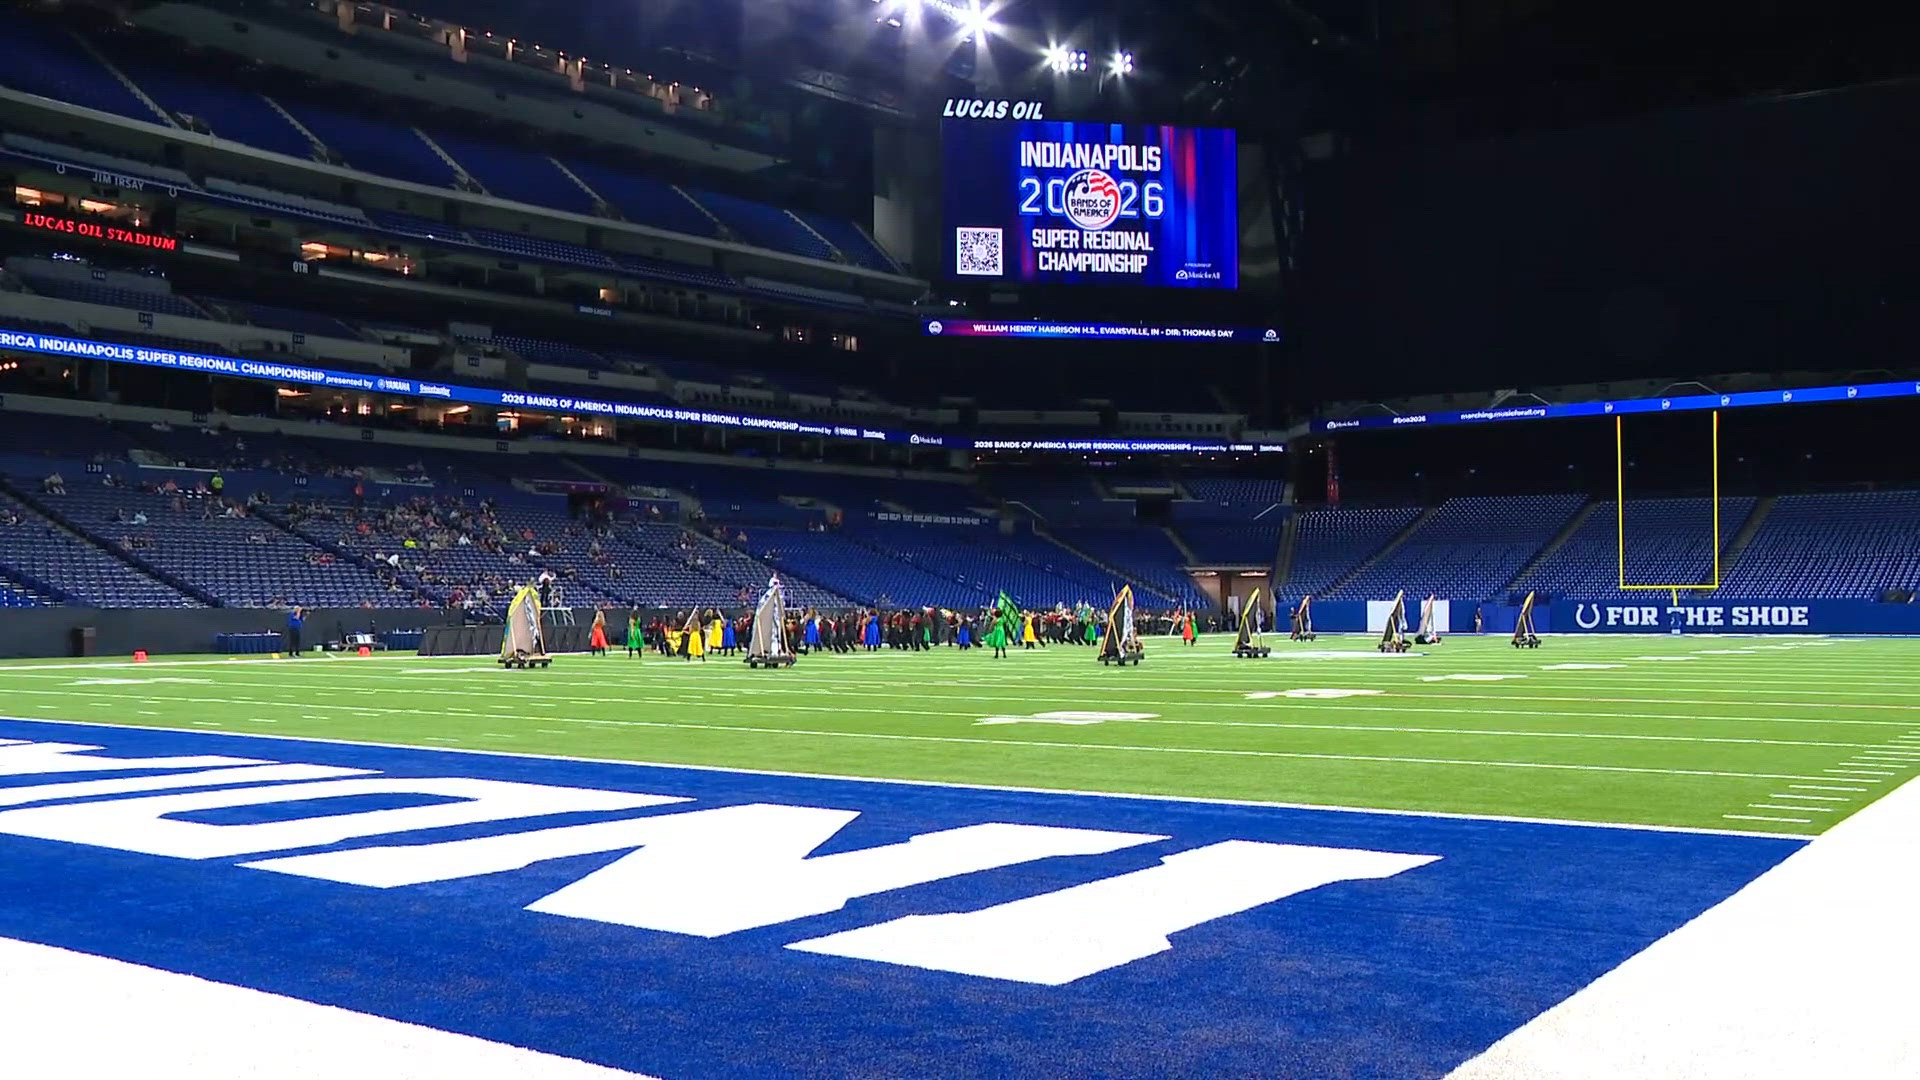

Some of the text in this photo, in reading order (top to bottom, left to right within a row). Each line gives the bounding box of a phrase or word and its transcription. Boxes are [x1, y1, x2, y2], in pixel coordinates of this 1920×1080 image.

[943, 99, 1043, 120] LUCAS OIL
[1020, 141, 1161, 172] INDIANAPOLIS
[92, 171, 145, 191] JIM IRSAY
[1071, 199, 1112, 208] BANDS OF
[1073, 208, 1109, 217] AMERICA
[24, 213, 177, 250] LUCAS OIL STADIUM
[1032, 228, 1154, 251] SUPER REGIONAL
[292, 261, 309, 274] QTR
[1038, 251, 1148, 274] CHAMPIONSHIP
[973, 324, 1008, 332] WILLIAM
[1010, 325, 1037, 333] HENRY
[1039, 325, 1081, 334] HARRISON
[1100, 327, 1150, 336] EVANSVILLE,
[1151, 328, 1160, 336] IN
[1165, 328, 1181, 336] DIR:
[1182, 329, 1216, 337] THOMAS
[1217, 329, 1234, 338] DAY
[39, 337, 134, 360] INDIANAPOLIS
[136, 350, 177, 365] SUPER
[179, 356, 239, 372] REGIONAL
[241, 362, 325, 382] CHAMPIONSHIP
[326, 375, 363, 387] presented
[363, 379, 373, 389] by
[385, 379, 411, 392] YAMAHA
[502, 393, 525, 404] 2026
[526, 395, 558, 408] BANDS
[560, 398, 572, 409] OF
[573, 400, 613, 413] AMERICA
[615, 404, 673, 419] INDIANAPOLIS
[675, 410, 700, 422] SUPER
[702, 413, 741, 426] REGIONAL
[742, 417, 798, 431] CHAMPIONSHIP
[799, 425, 825, 434] presented
[825, 426, 831, 435] by
[1460, 408, 1545, 420] marching.musicforall.org
[994, 441, 1020, 449] BANDS
[1021, 441, 1032, 449] OF
[1033, 441, 1066, 449] AMERICA
[1067, 442, 1092, 450] SUPER
[1093, 442, 1130, 450] REGIONAL
[1131, 443, 1192, 451] CHAMPIONSHIPS
[1606, 606, 1659, 626] FOR
[1732, 606, 1809, 626] SHOE
[0, 737, 1443, 985] INDI
